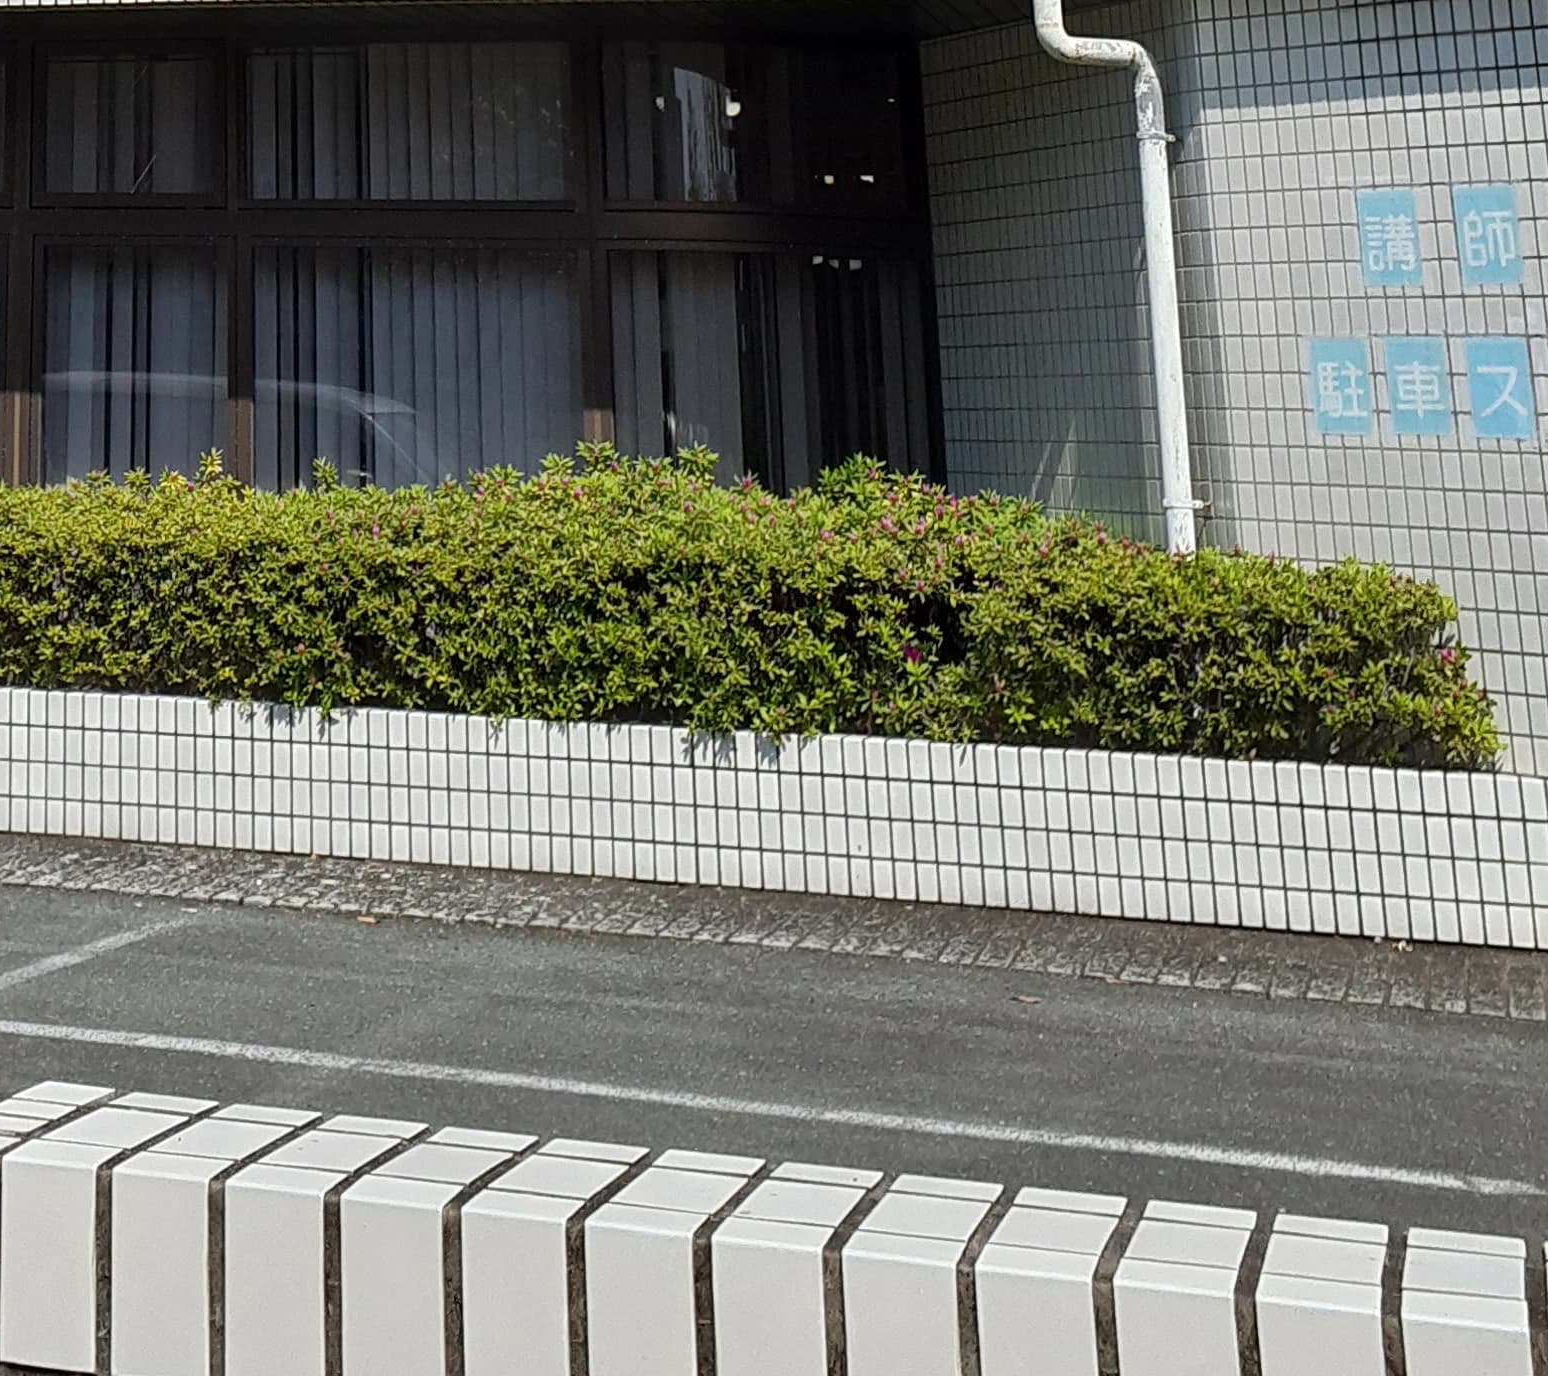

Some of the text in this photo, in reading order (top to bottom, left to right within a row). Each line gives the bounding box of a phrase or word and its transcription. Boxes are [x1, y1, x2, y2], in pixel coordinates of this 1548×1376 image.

[1363, 208, 1518, 273] 講師
[1316, 359, 1529, 420] 駐車ス
